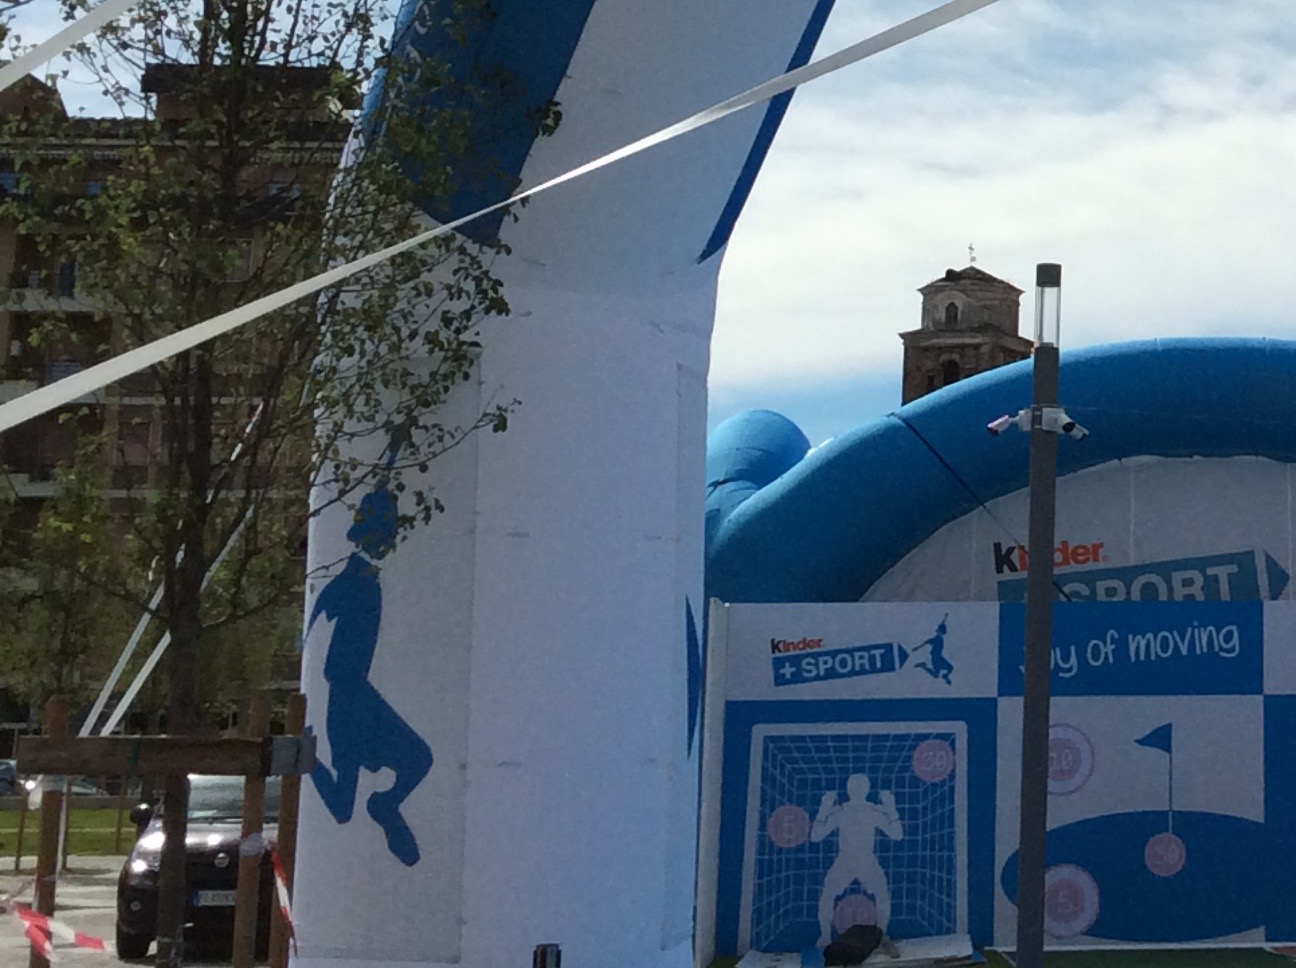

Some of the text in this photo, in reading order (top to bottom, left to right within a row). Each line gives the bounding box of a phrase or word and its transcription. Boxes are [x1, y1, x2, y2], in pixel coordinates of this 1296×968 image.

[1086, 629, 1119, 667] of
[1128, 620, 1240, 662] moving
[1057, 889, 1074, 913] 5
